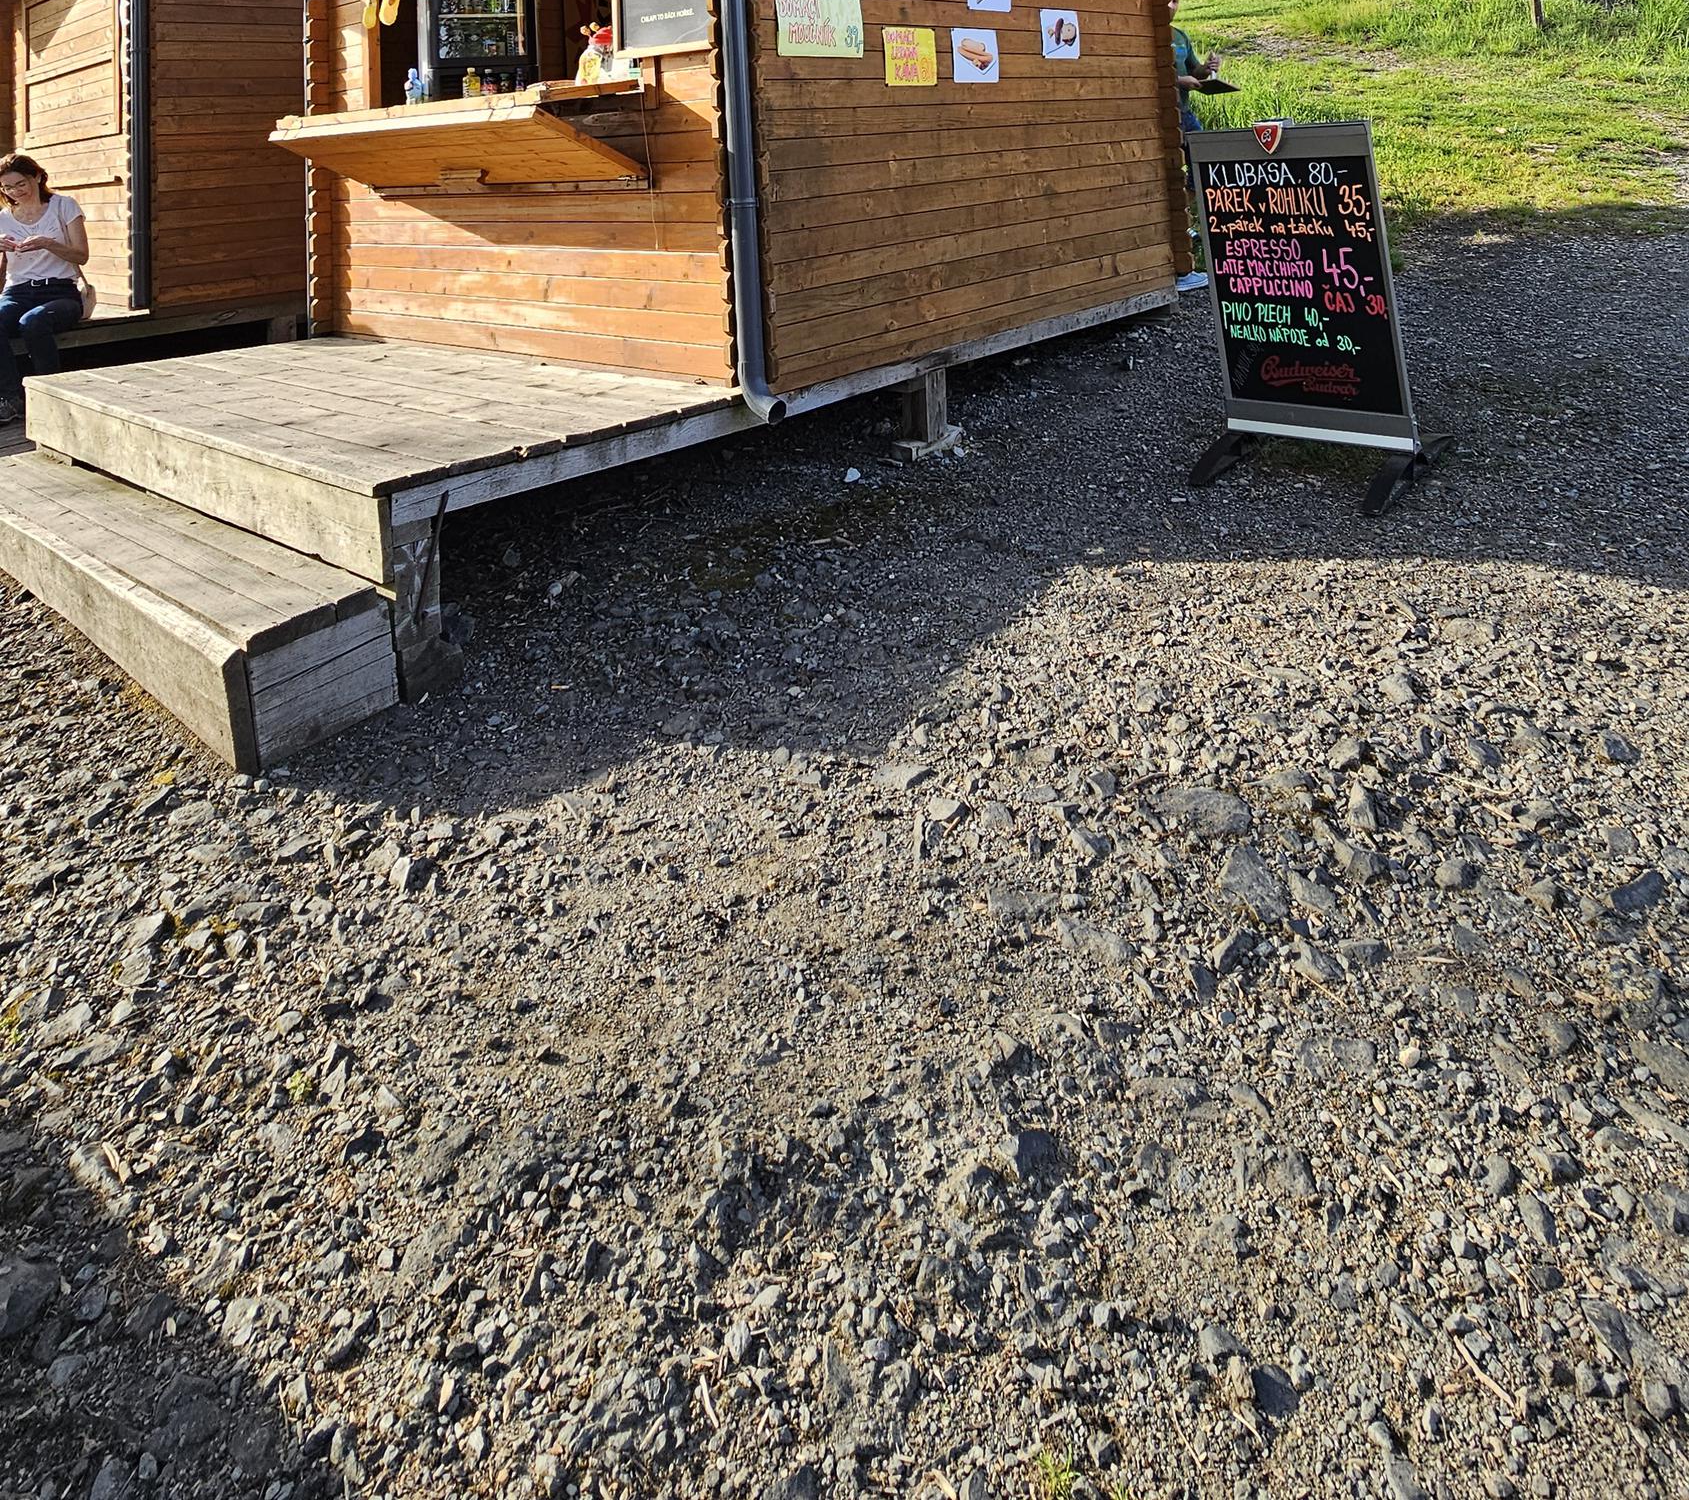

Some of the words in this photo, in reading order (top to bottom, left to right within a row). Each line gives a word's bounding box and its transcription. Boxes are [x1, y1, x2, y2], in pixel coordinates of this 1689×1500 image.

[1205, 185, 1255, 213] PÁREK
[1259, 202, 1266, 213] v
[1270, 221, 1287, 234] na
[1288, 217, 1335, 237] tácku
[1225, 238, 1302, 261] ESPRESSO
[1215, 258, 1245, 276] LATTE
[1246, 258, 1314, 278] MACCHIATO
[1229, 276, 1314, 300] CAPPUCCINO
[1322, 284, 1356, 314] ČAJ
[1221, 301, 1252, 330] PIVO
[1254, 302, 1292, 326] PLECH
[1230, 323, 1267, 344] NEALKO
[1268, 324, 1312, 348] NÁPOJE
[1315, 332, 1330, 348] od
[1260, 355, 1359, 385] Budweiser
[1302, 377, 1360, 397] Budvar
